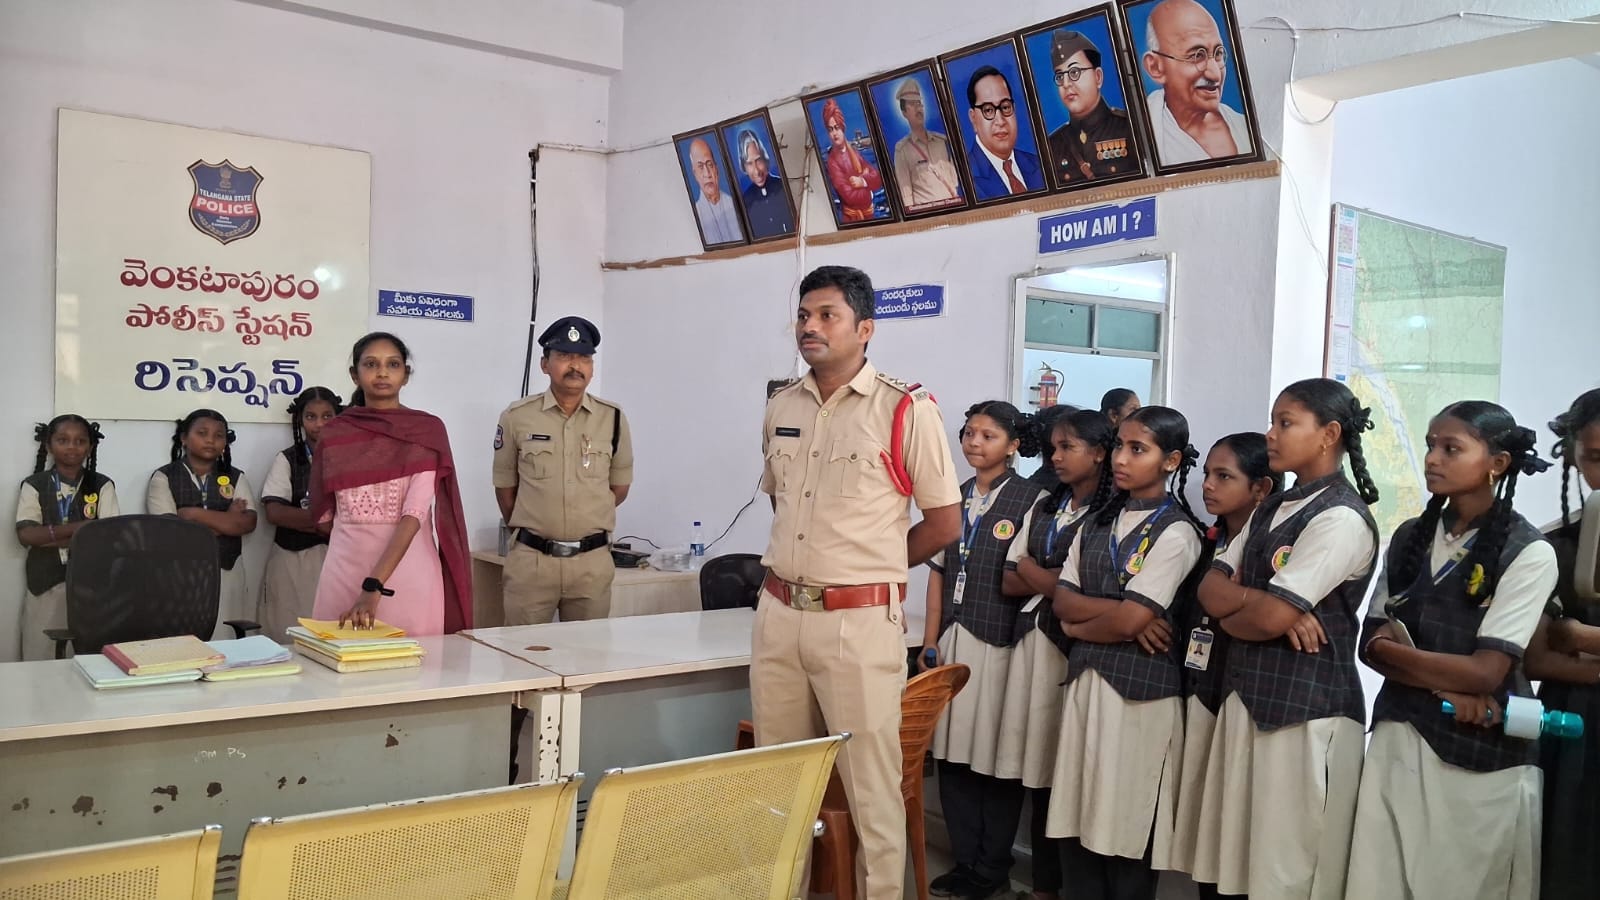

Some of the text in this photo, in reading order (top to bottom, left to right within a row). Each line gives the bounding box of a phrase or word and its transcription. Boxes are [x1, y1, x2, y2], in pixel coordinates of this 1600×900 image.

[196, 196, 254, 215] POLICE
[199, 188, 233, 201] TELANGANA
[233, 194, 252, 202] STATE
[1050, 220, 1088, 244] HOW
[1091, 215, 1117, 237] AM
[1121, 212, 1128, 232] I
[120, 258, 320, 302] వెంకటాపురం
[125, 303, 313, 346] పోలీస్ స్టేషన్
[134, 358, 304, 409] రిసెప్షన్
